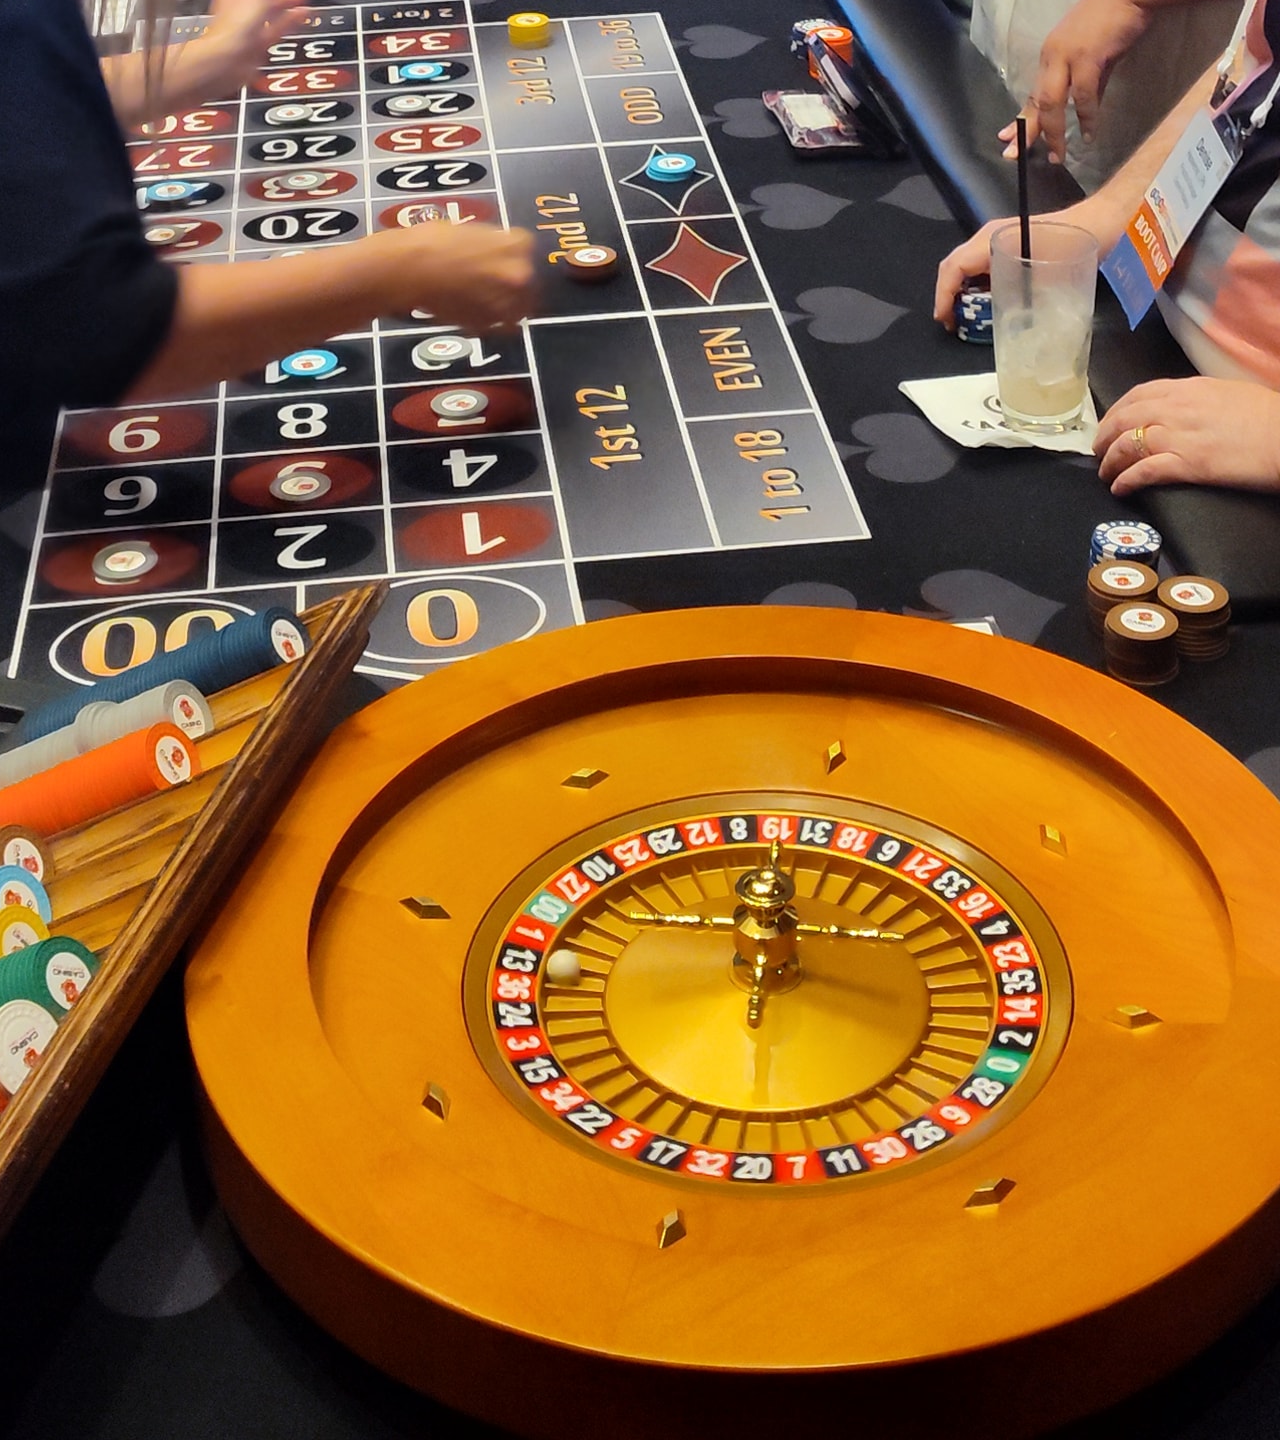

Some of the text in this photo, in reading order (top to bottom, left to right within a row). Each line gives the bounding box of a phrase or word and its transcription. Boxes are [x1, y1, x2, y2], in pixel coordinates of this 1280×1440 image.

[267, 40, 336, 61] 35
[382, 32, 451, 54] 34
[266, 69, 337, 92] 32
[506, 55, 557, 107] 3rd 12
[620, 86, 665, 126] ODD
[261, 135, 339, 161] 26
[390, 126, 465, 152] 25
[135, 144, 212, 171] 27
[392, 162, 471, 190] 22
[535, 193, 581, 219] 12
[259, 211, 342, 241] 20
[1134, 214, 1157, 249] BOOT
[699, 325, 763, 392] EVEN
[276, 402, 329, 440] 8
[575, 384, 643, 471] 1st 12
[442, 448, 498, 489] 4
[733, 428, 811, 523] 1 to 18
[274, 523, 328, 570] 2
[462, 511, 507, 556] 1
[406, 588, 479, 648] 0
[647, 828, 683, 854] 29
[684, 821, 719, 845] 12
[730, 817, 748, 840] 8
[762, 817, 793, 840] 19
[799, 819, 833, 843] 31
[836, 826, 869, 852] 18
[613, 839, 650, 867] 25
[876, 840, 901, 862] 6
[581, 856, 617, 882] 10
[902, 852, 943, 880] 21
[556, 871, 591, 903] 27
[932, 869, 972, 899] 33
[530, 895, 568, 923] 00
[957, 892, 996, 919] 16
[515, 925, 545, 941] 1
[979, 919, 1011, 937] 4
[502, 949, 537, 973] 13
[992, 941, 1031, 968] 23
[497, 974, 531, 1000] 36
[1002, 969, 1037, 995] 35
[498, 1002, 535, 1027] 24
[1003, 997, 1038, 1022] 14
[507, 1035, 541, 1051] 3
[998, 1029, 1033, 1047] 2
[519, 1057, 560, 1083] 15
[986, 1056, 1020, 1073] 0
[540, 1082, 584, 1111] 34
[961, 1077, 1005, 1106] 28
[567, 1103, 613, 1135] 22
[939, 1104, 971, 1126] 9
[611, 1128, 642, 1150] 5
[901, 1120, 947, 1150] 26
[646, 1140, 687, 1165] 17
[825, 1148, 863, 1173] 11
[863, 1136, 909, 1164] 30
[686, 1150, 729, 1177] 32
[732, 1155, 773, 1181] 20
[786, 1155, 808, 1179] 7
